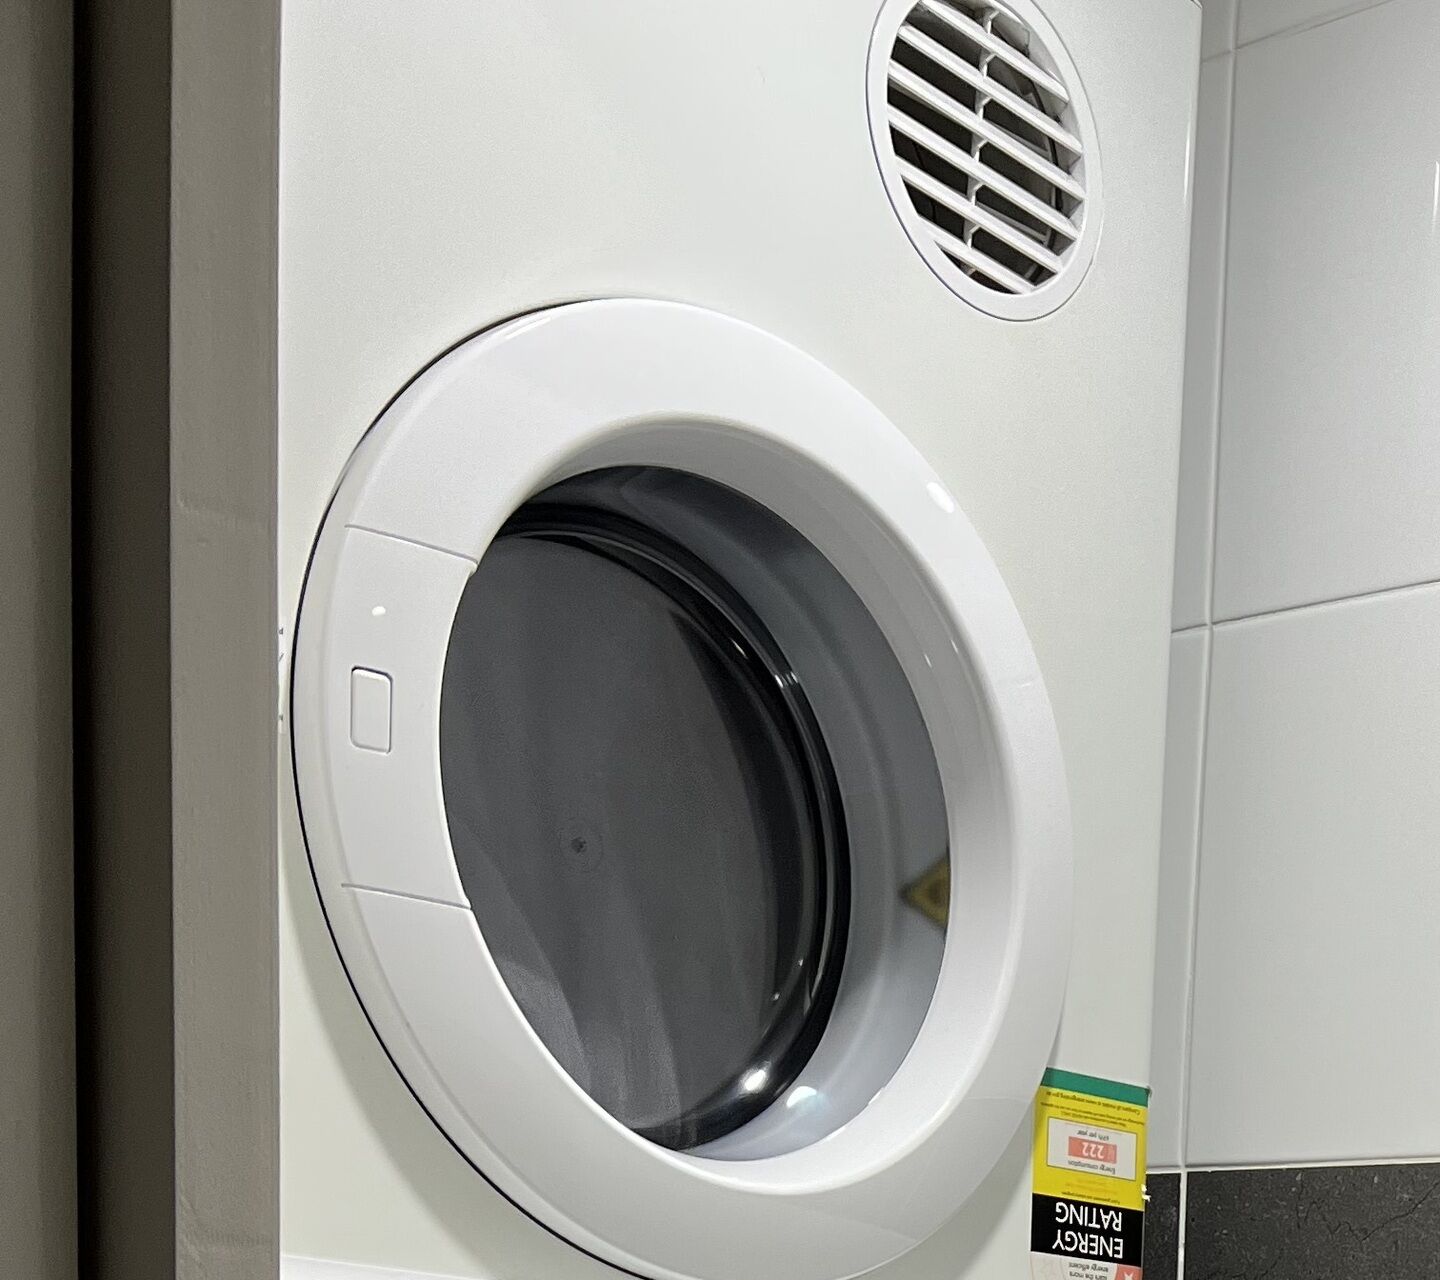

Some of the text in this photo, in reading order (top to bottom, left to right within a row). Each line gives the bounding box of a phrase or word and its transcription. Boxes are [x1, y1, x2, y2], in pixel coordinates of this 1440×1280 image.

[1081, 1142, 1105, 1159] 222
[1068, 1160, 1116, 1175] Energy consumption
[1055, 1202, 1122, 1232] RATING
[1052, 1229, 1123, 1259] ENERGY
